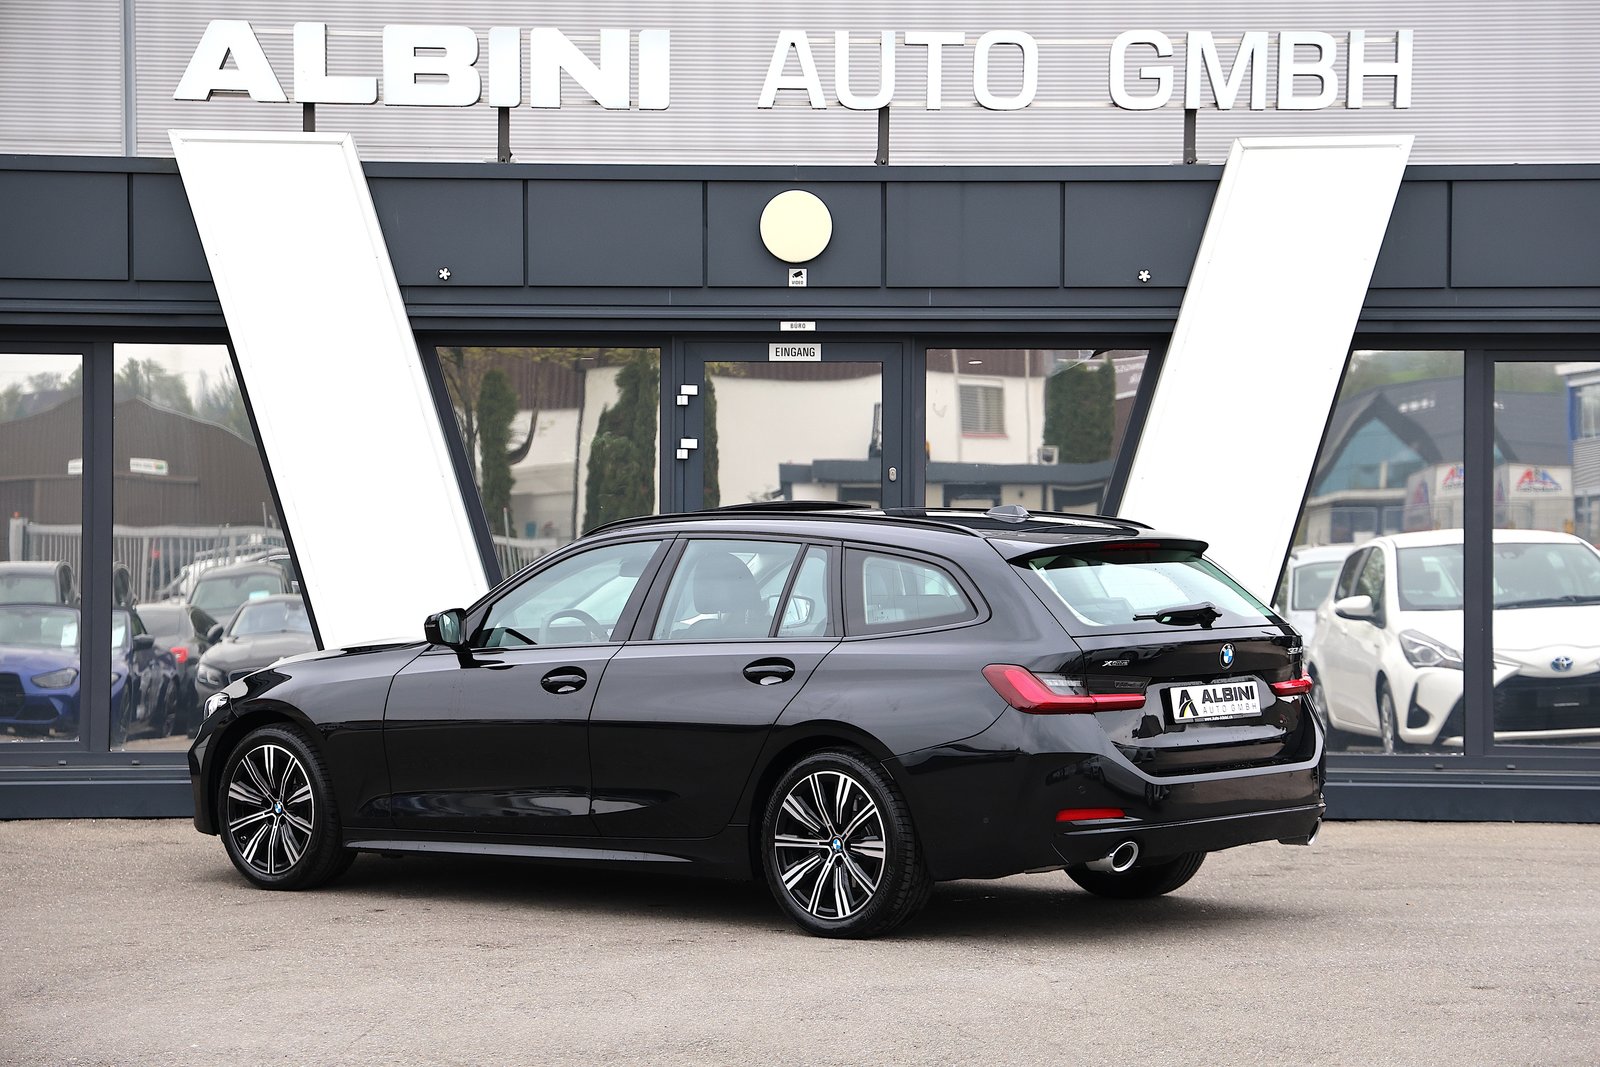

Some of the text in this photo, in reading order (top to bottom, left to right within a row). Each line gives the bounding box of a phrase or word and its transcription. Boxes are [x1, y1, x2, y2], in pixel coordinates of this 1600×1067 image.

[173, 20, 1413, 111] ALBINI AUTO GMBH
[775, 347, 816, 357] EINGANG
[1202, 685, 1255, 704] ALBINI
[1203, 702, 1257, 714] AUTO GMBH
